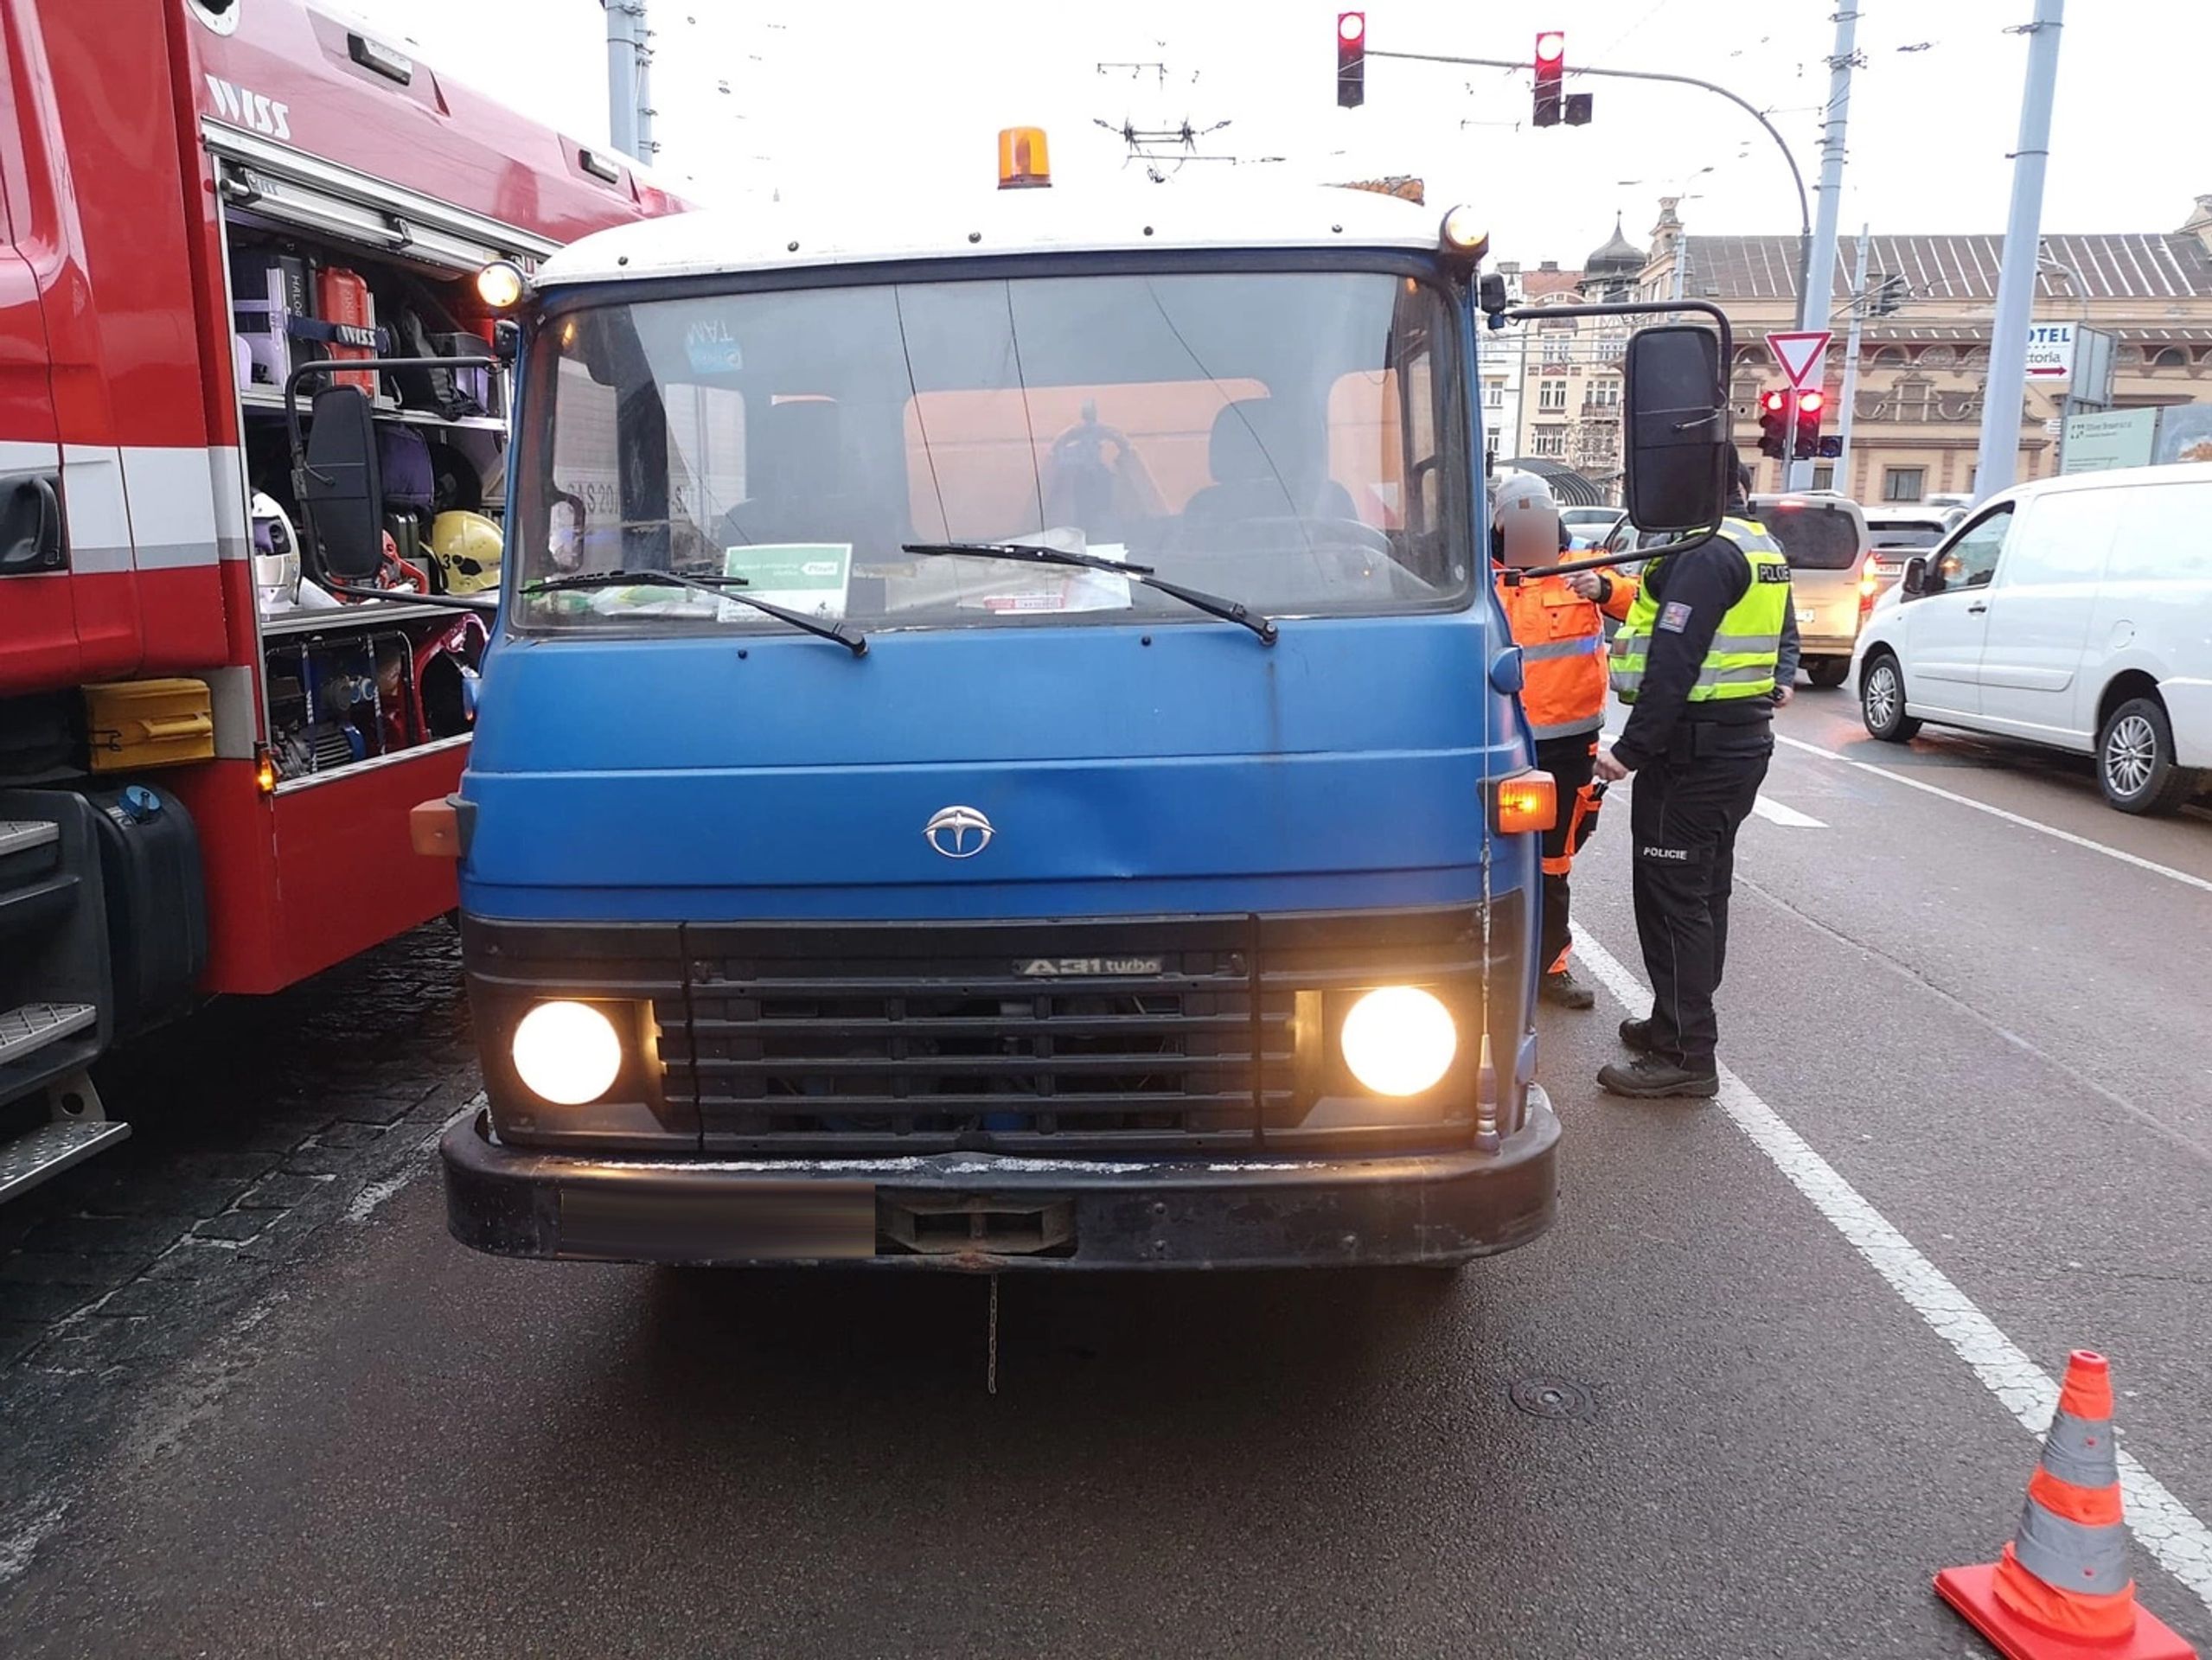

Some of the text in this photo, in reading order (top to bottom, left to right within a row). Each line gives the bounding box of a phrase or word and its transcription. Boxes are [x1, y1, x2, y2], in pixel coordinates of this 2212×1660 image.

[204, 73, 291, 141] WISS
[341, 325, 376, 347] WISS
[1643, 846, 1688, 860] POLICIE
[1023, 958, 1160, 974] A31 turbo
